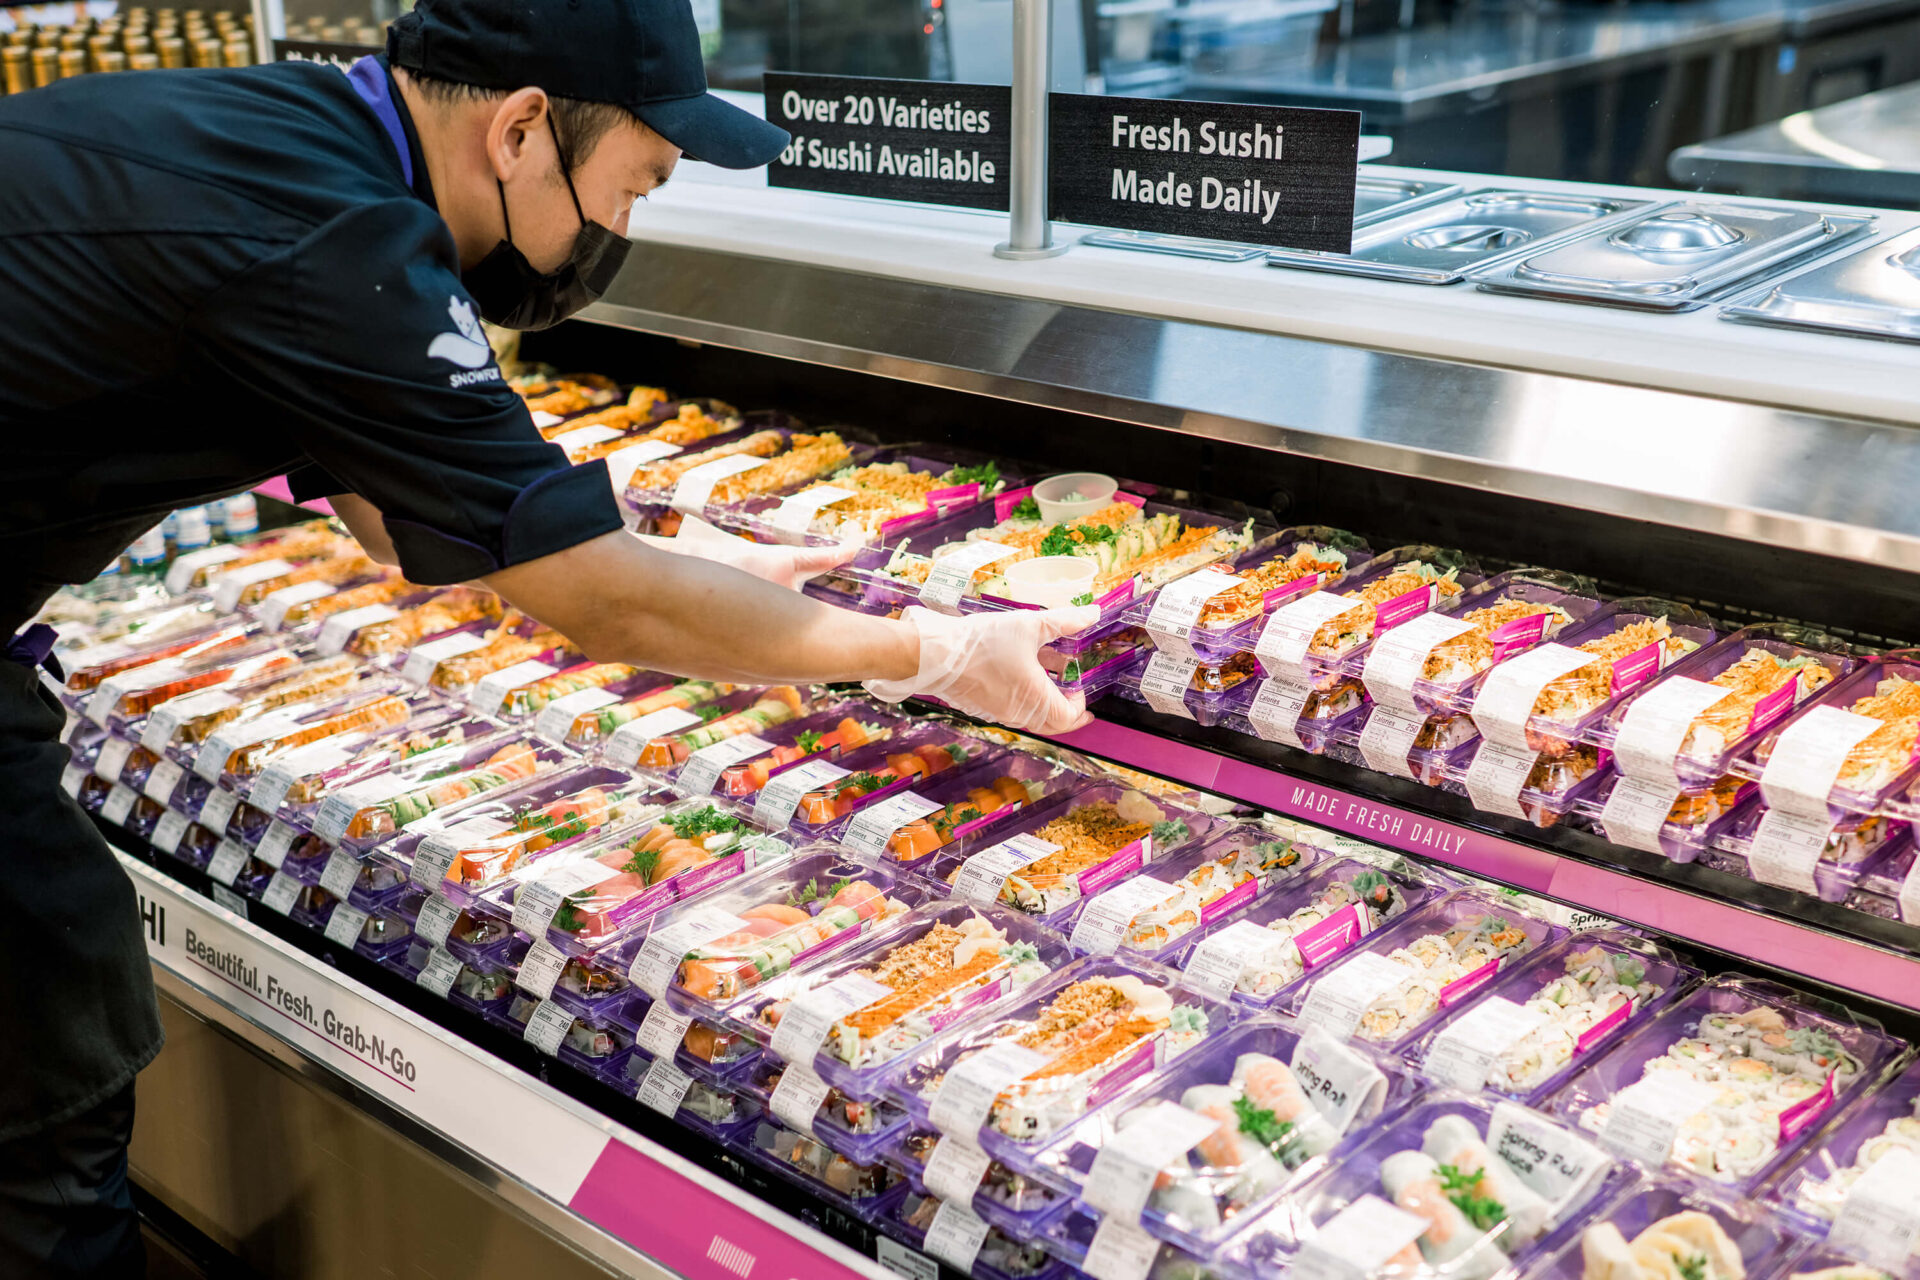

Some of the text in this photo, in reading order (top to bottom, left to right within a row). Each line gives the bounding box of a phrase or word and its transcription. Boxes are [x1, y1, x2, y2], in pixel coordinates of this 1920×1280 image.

[782, 90, 990, 134] Over 20 Varieties
[1112, 115, 1283, 160] Fresh Sushi
[808, 138, 872, 173] Sushi
[876, 145, 996, 184] Available
[1111, 168, 1281, 225] Made Daily
[1147, 620, 1188, 637] Calories 280
[1153, 660, 1175, 673] Nutrition
[1175, 665, 1189, 676] Facts
[1143, 679, 1184, 695] Calories 280
[1258, 693, 1303, 712] Calories 250
[1373, 714, 1419, 734] Calories 250
[1479, 752, 1529, 773] Calories 250
[1291, 786, 1467, 856] MADE FRESH DAILY
[963, 865, 1004, 887] Calories 240
[186, 928, 417, 1082] Beautiful. Fresh. Grab-N-Go
[648, 1013, 666, 1028] Calories
[648, 1075, 684, 1101] Calories 240
